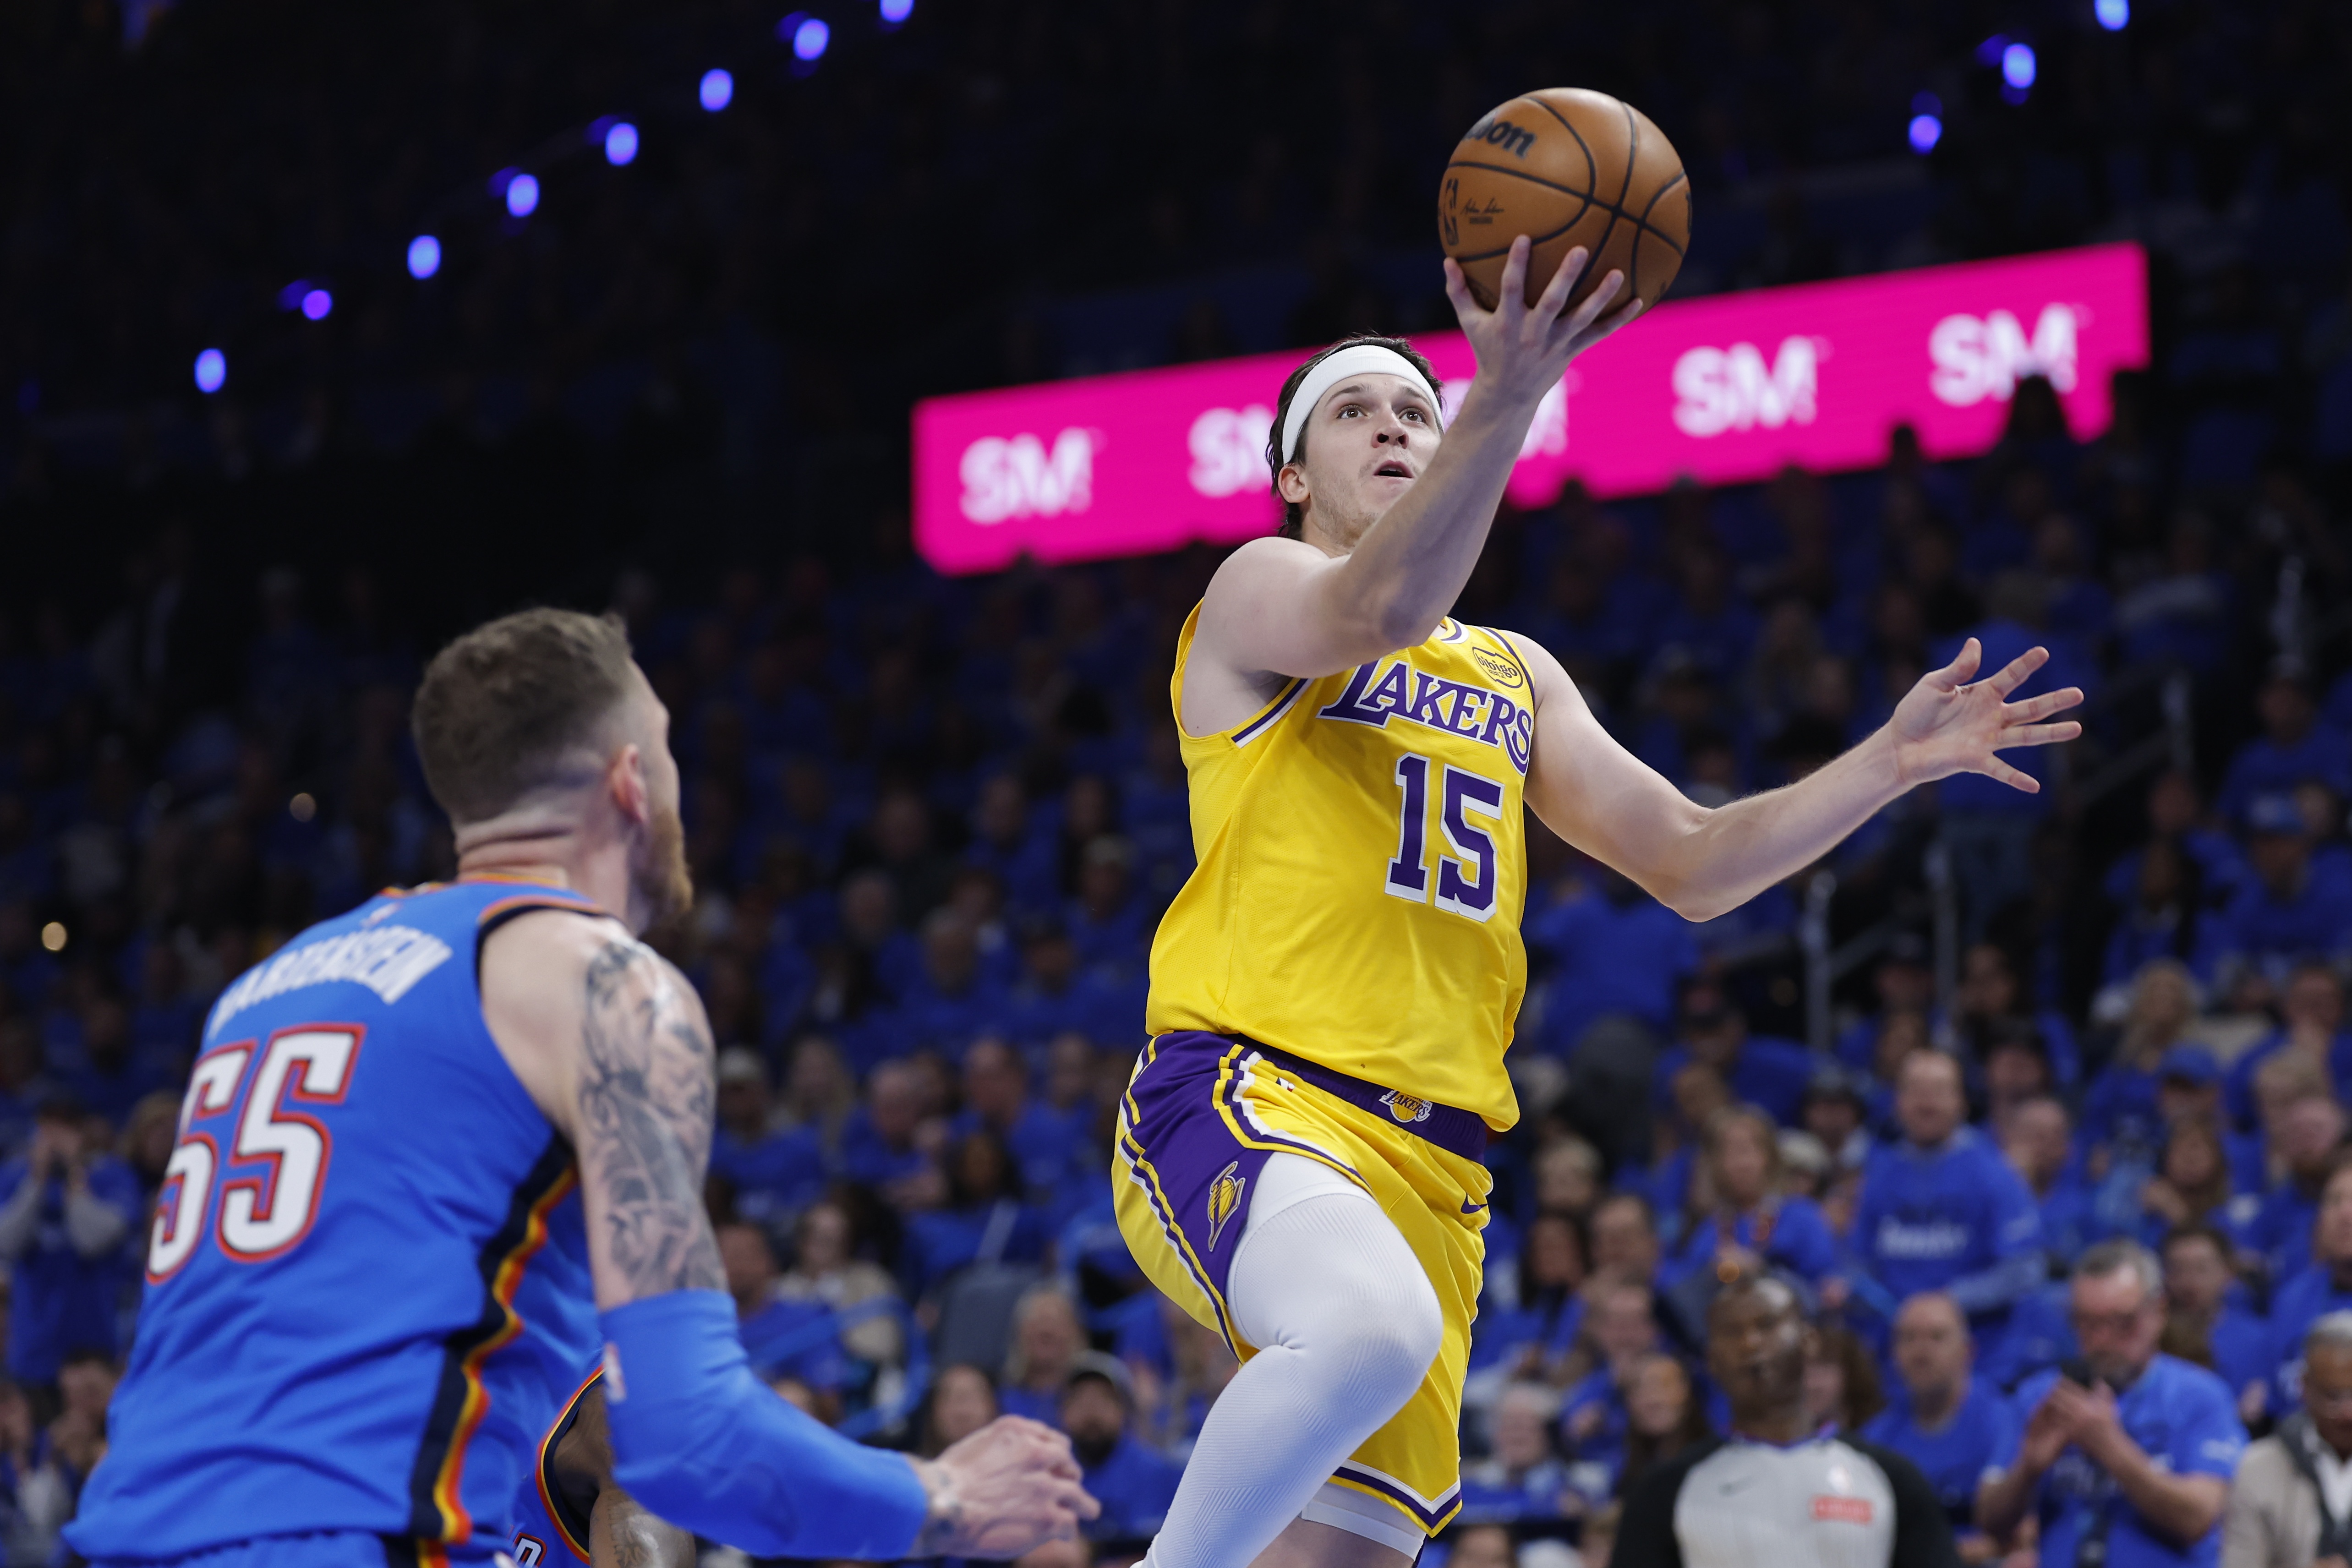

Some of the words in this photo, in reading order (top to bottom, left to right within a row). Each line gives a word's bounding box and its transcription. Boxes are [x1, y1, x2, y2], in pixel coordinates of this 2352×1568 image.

[1315, 655, 1533, 777] LAKERS
[1474, 653, 1517, 678] bibigo
[1384, 752, 1504, 923] 15
[147, 1023, 366, 1284] 55
[1385, 1091, 1429, 1120] LAKERS
